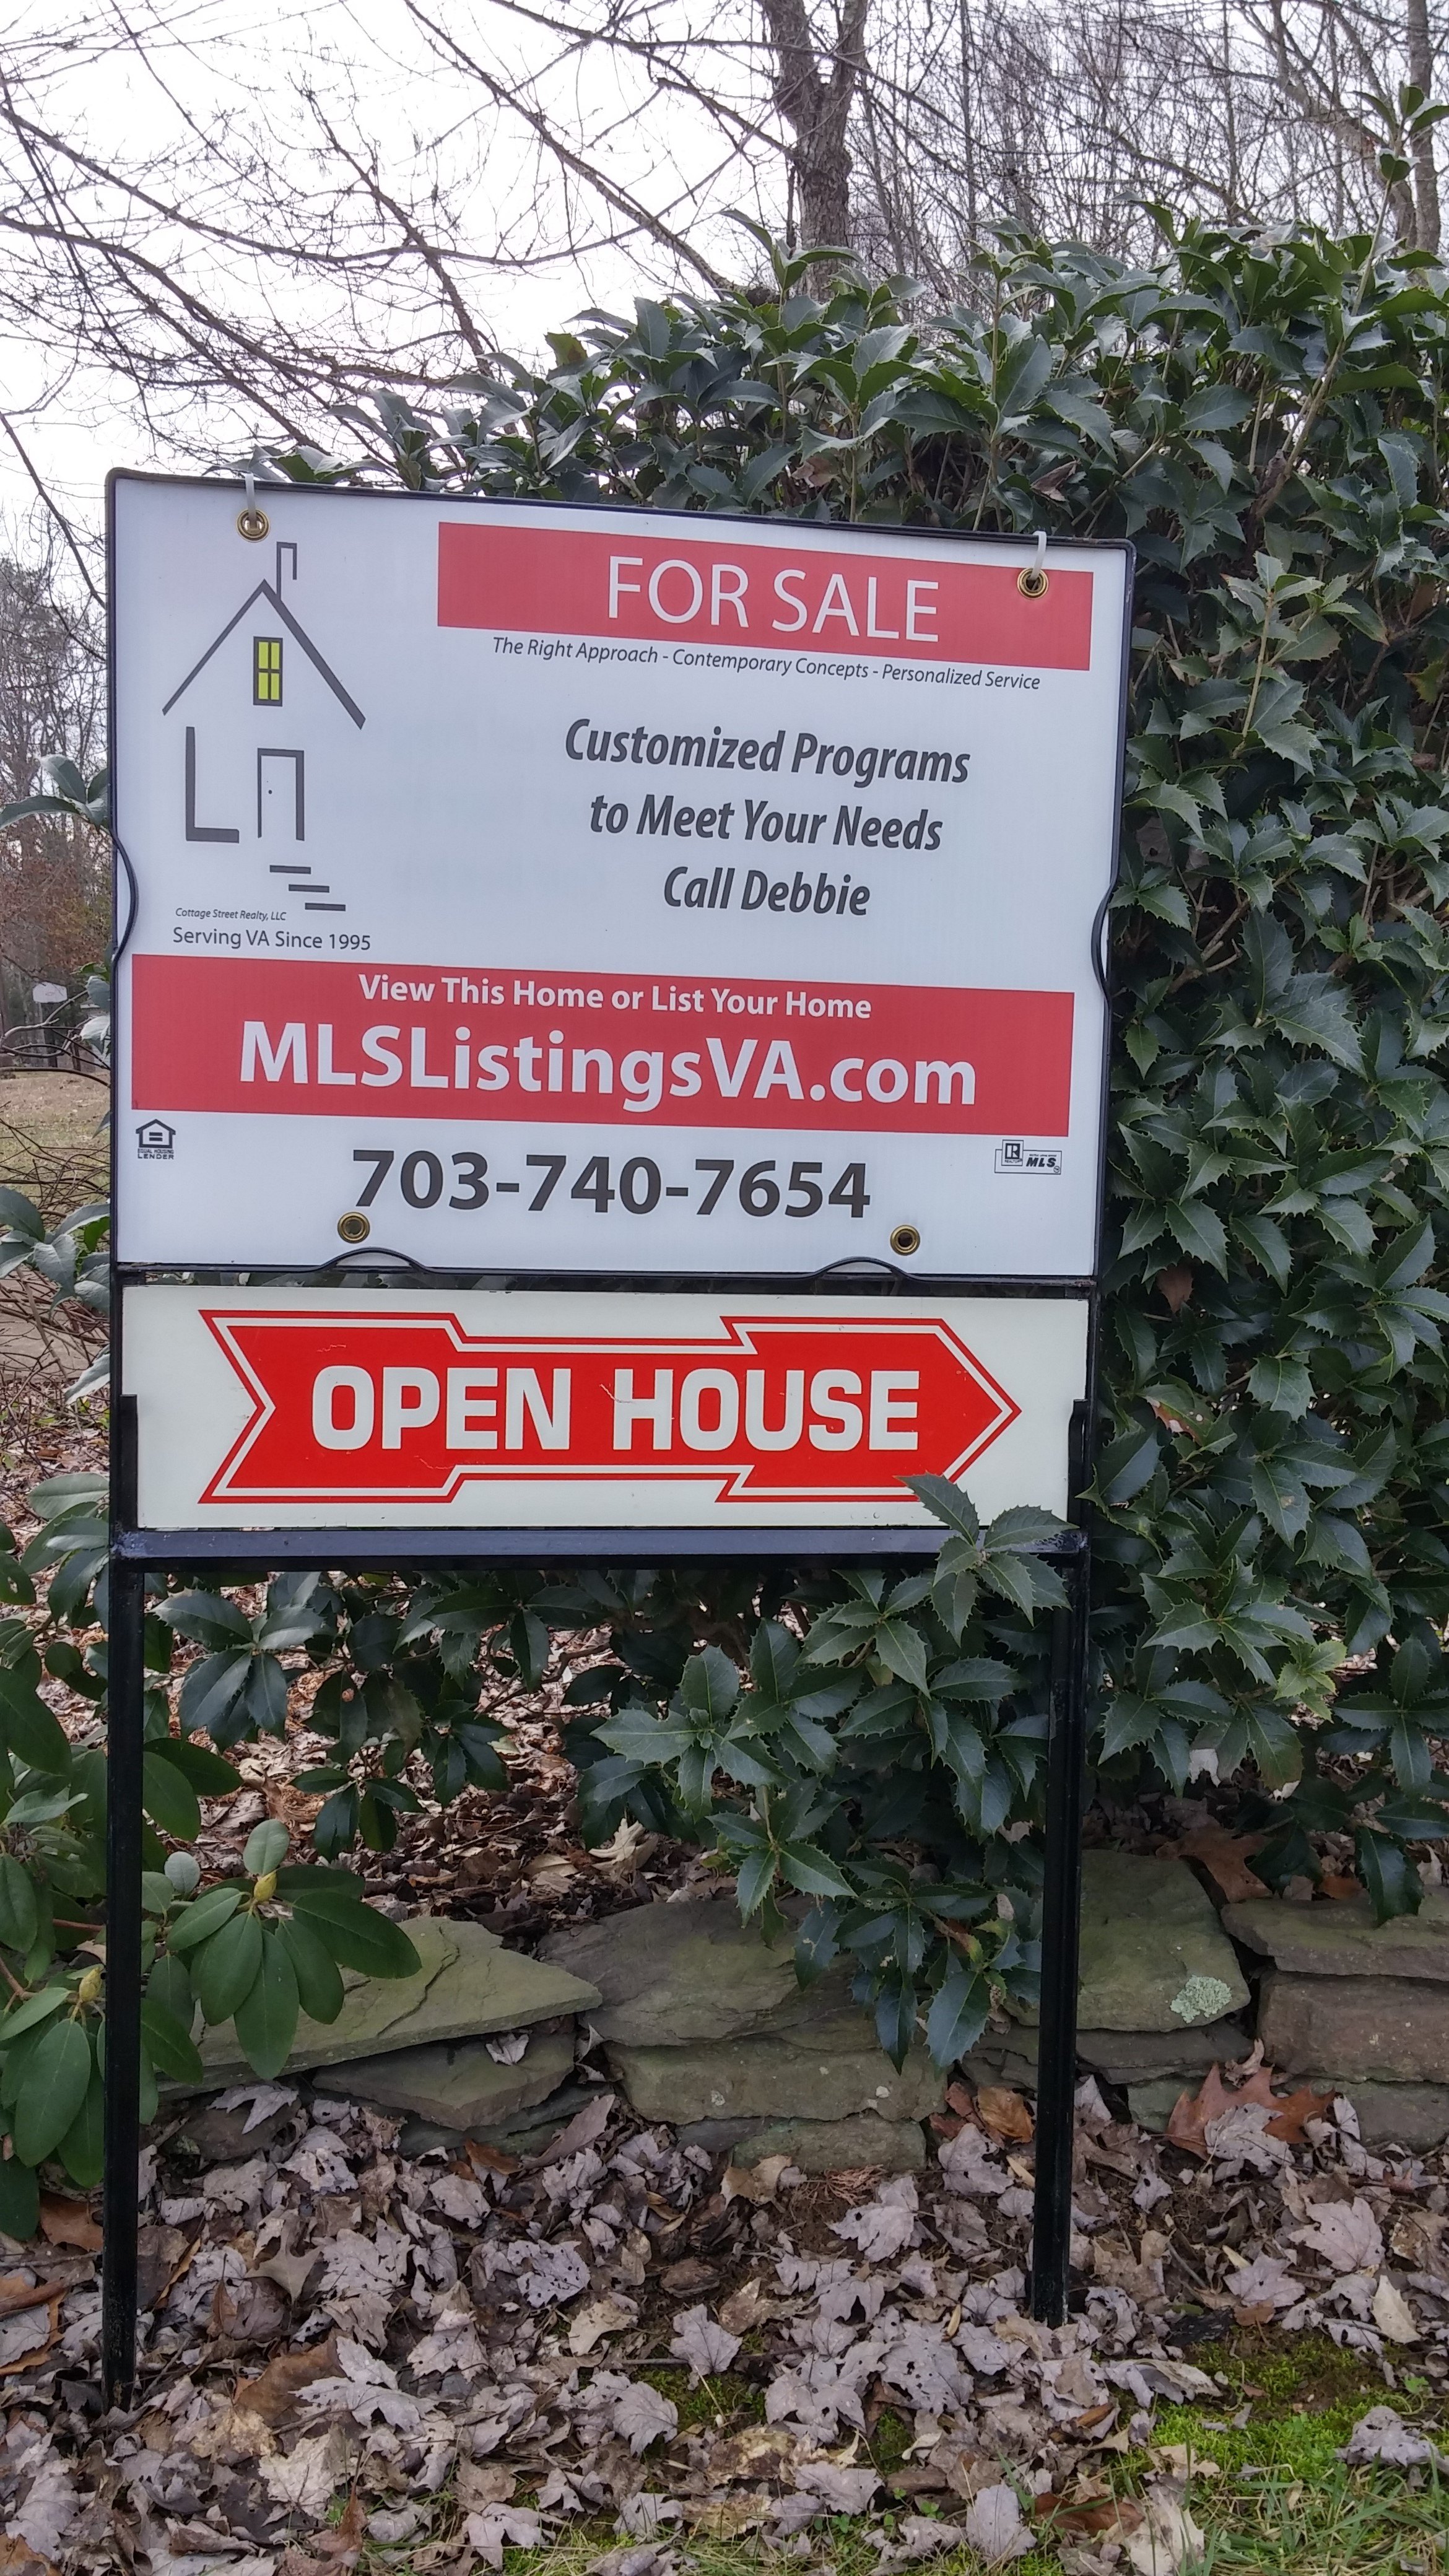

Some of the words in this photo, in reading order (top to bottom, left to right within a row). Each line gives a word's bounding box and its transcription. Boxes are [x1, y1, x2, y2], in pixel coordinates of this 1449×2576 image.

[609, 556, 748, 627] FOR
[772, 570, 938, 642] SALE
[494, 637, 524, 654] The
[528, 640, 573, 661] Right
[576, 642, 658, 664] Approach
[672, 649, 792, 672] Contemporary
[796, 658, 868, 680] Concepts
[882, 664, 982, 686] Personalized
[985, 672, 1040, 689] Service
[565, 718, 785, 772] Customized
[791, 733, 970, 788] Programs
[591, 795, 629, 833] to
[637, 794, 736, 840] Meet
[743, 799, 827, 845] Your
[833, 805, 943, 851] Needs
[175, 908, 211, 919] Cottage
[212, 910, 238, 919] Street
[240, 911, 268, 921] Realty,
[271, 912, 286, 921] LLC
[664, 866, 736, 909] Call
[741, 869, 871, 916] Debbie
[173, 927, 242, 949] Serving
[246, 930, 270, 946] VA
[276, 931, 323, 948] Since
[329, 934, 371, 951] 1995
[359, 974, 435, 1001] View
[442, 977, 504, 1004] This
[514, 980, 603, 1007] Home
[611, 990, 643, 1011] or
[653, 986, 704, 1012] List
[711, 988, 778, 1014] Your
[786, 991, 871, 1018] Home
[241, 1021, 975, 1112] MLSListingsVA.com
[352, 1149, 871, 1218] 703-740-7654
[1026, 1157, 1056, 1167] MLS
[312, 1365, 571, 1450] OPEN
[612, 1368, 920, 1451] HOUSE
